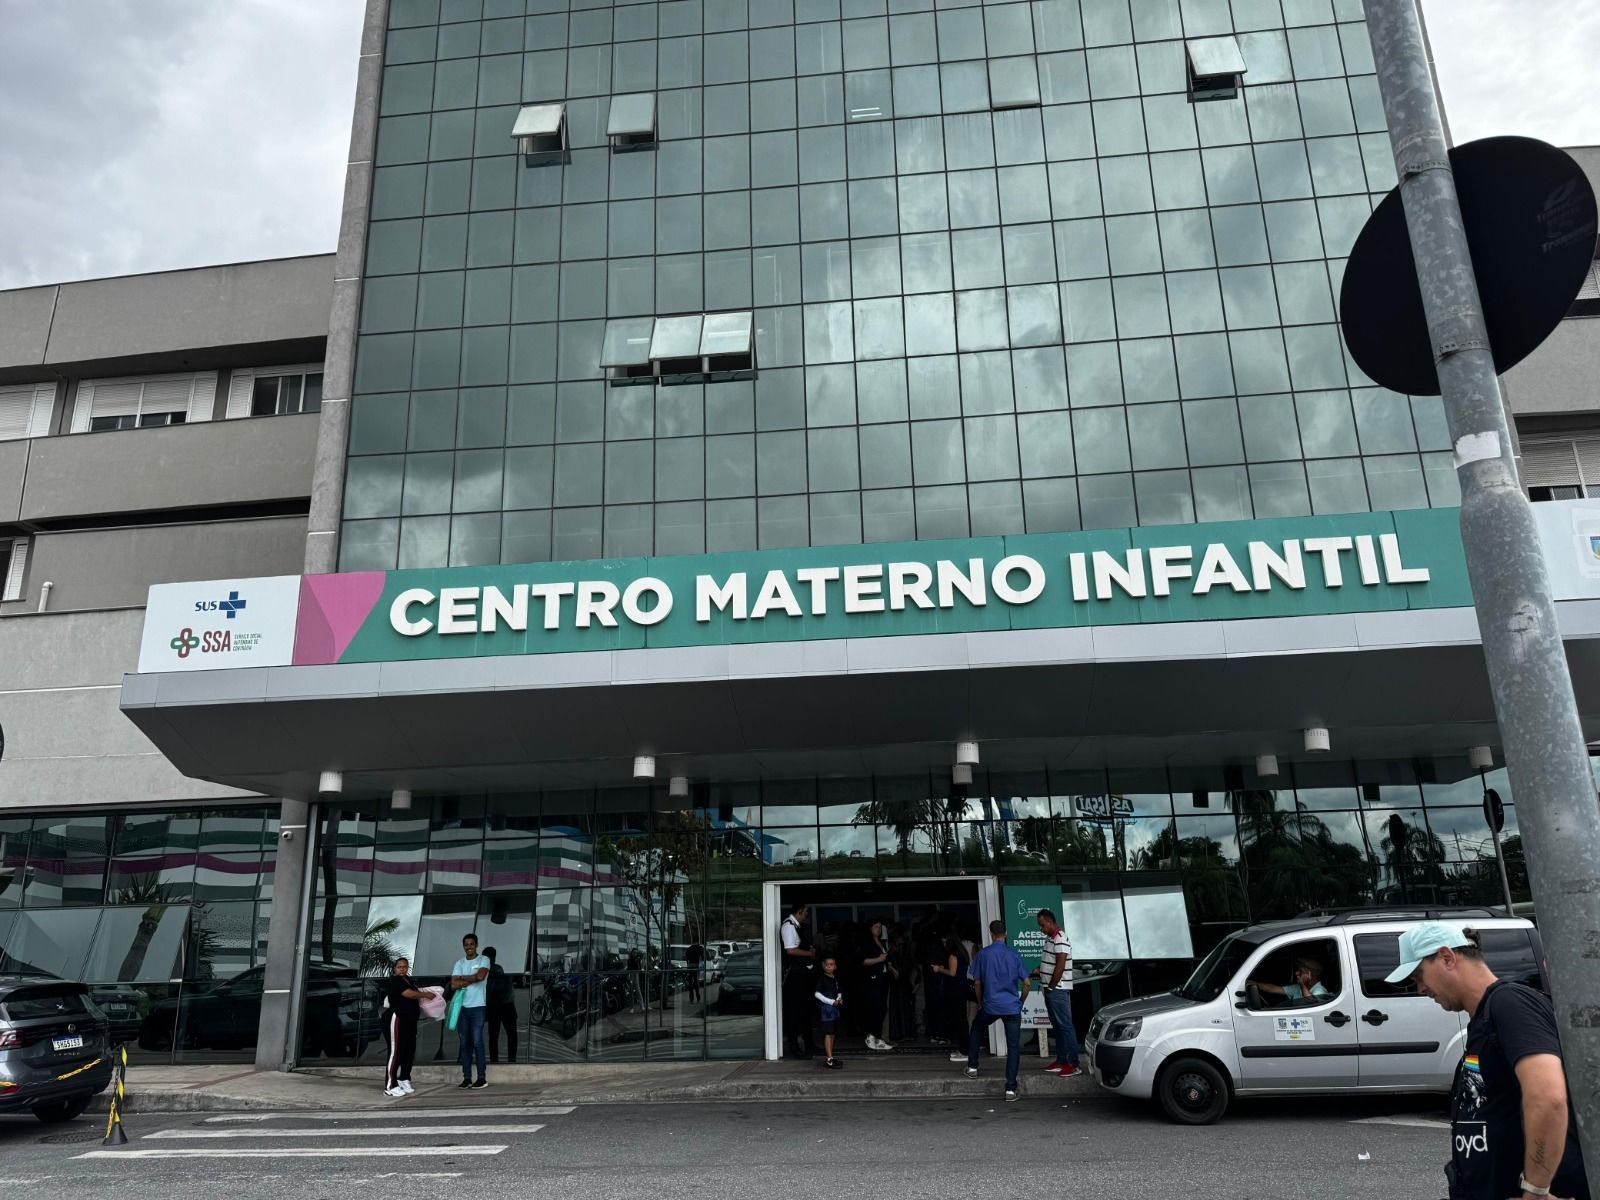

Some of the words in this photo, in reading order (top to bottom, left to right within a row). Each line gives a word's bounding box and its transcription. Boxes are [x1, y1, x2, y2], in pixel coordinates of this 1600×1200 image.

[388, 576, 675, 637] CENTRO
[695, 554, 1047, 623] MATERNO
[1068, 532, 1432, 603] INFANTIL
[194, 600, 218, 612] SUS
[201, 630, 231, 653] SSA
[1013, 939, 1045, 947] PRINCI
[1018, 931, 1048, 939] ACESS
[1455, 1125, 1488, 1159] oyd
